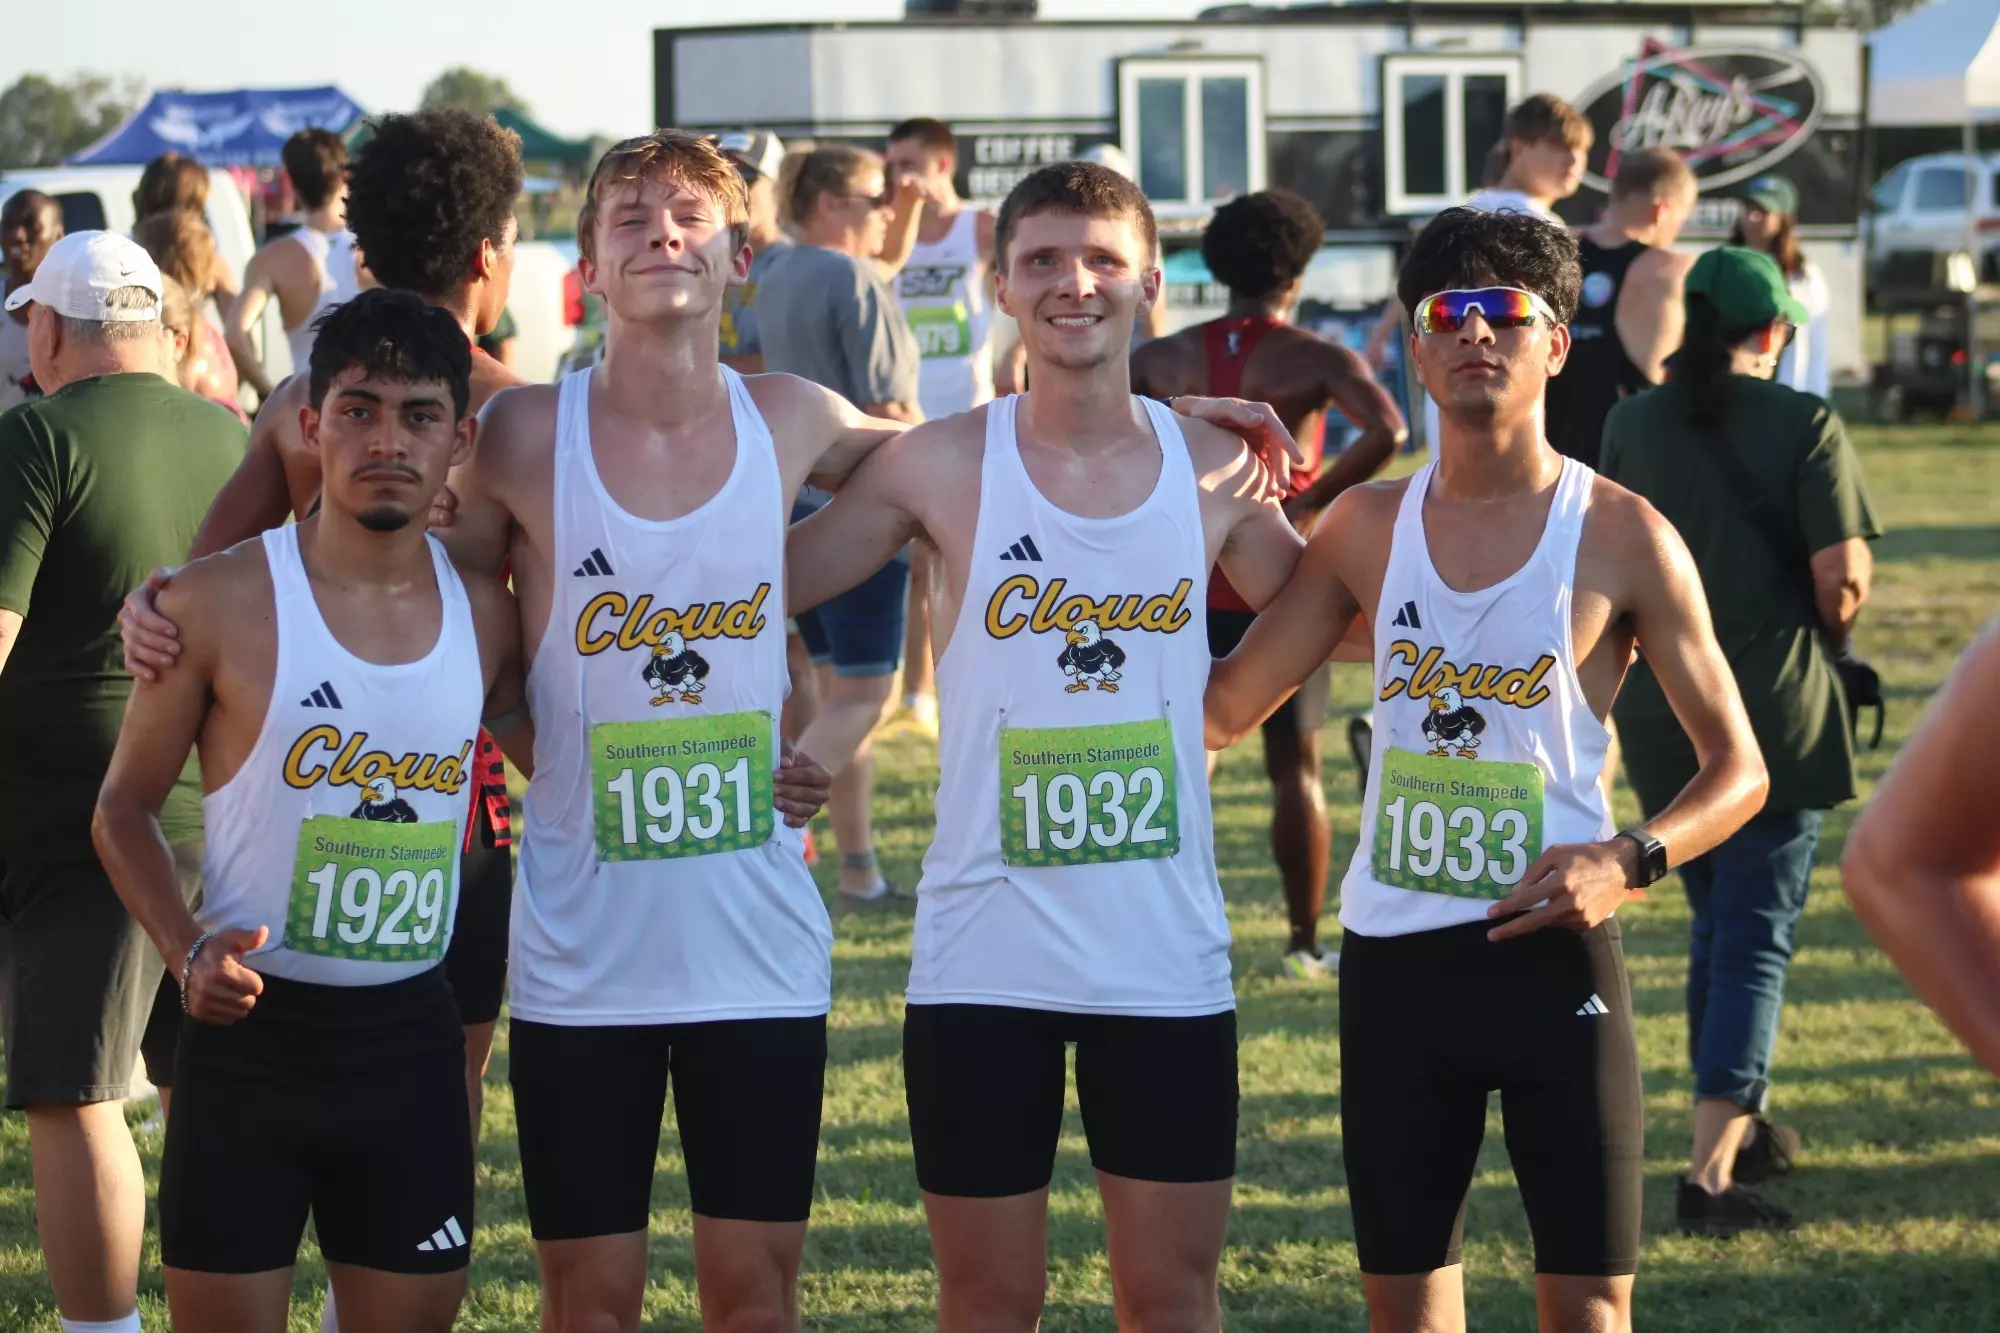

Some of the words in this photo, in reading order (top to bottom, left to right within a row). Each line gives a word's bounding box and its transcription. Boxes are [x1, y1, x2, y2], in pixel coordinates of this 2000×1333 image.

[575, 583, 771, 656] Cloud
[985, 574, 1193, 640] Cloud
[1379, 639, 1556, 710] Cloud
[283, 724, 474, 795] Cloud
[606, 743, 677, 760] Southern
[682, 734, 757, 757] Stampede
[1012, 749, 1082, 766] Southern
[1086, 742, 1160, 764] Stampede
[607, 756, 751, 845] 1931
[1012, 765, 1167, 850] 1932
[1390, 769, 1445, 795] Southern
[1450, 781, 1528, 801] Stampede
[314, 836, 385, 860] Southern
[390, 844, 447, 862] Stampede
[1385, 794, 1529, 885] 1933
[307, 861, 445, 945] 1929
